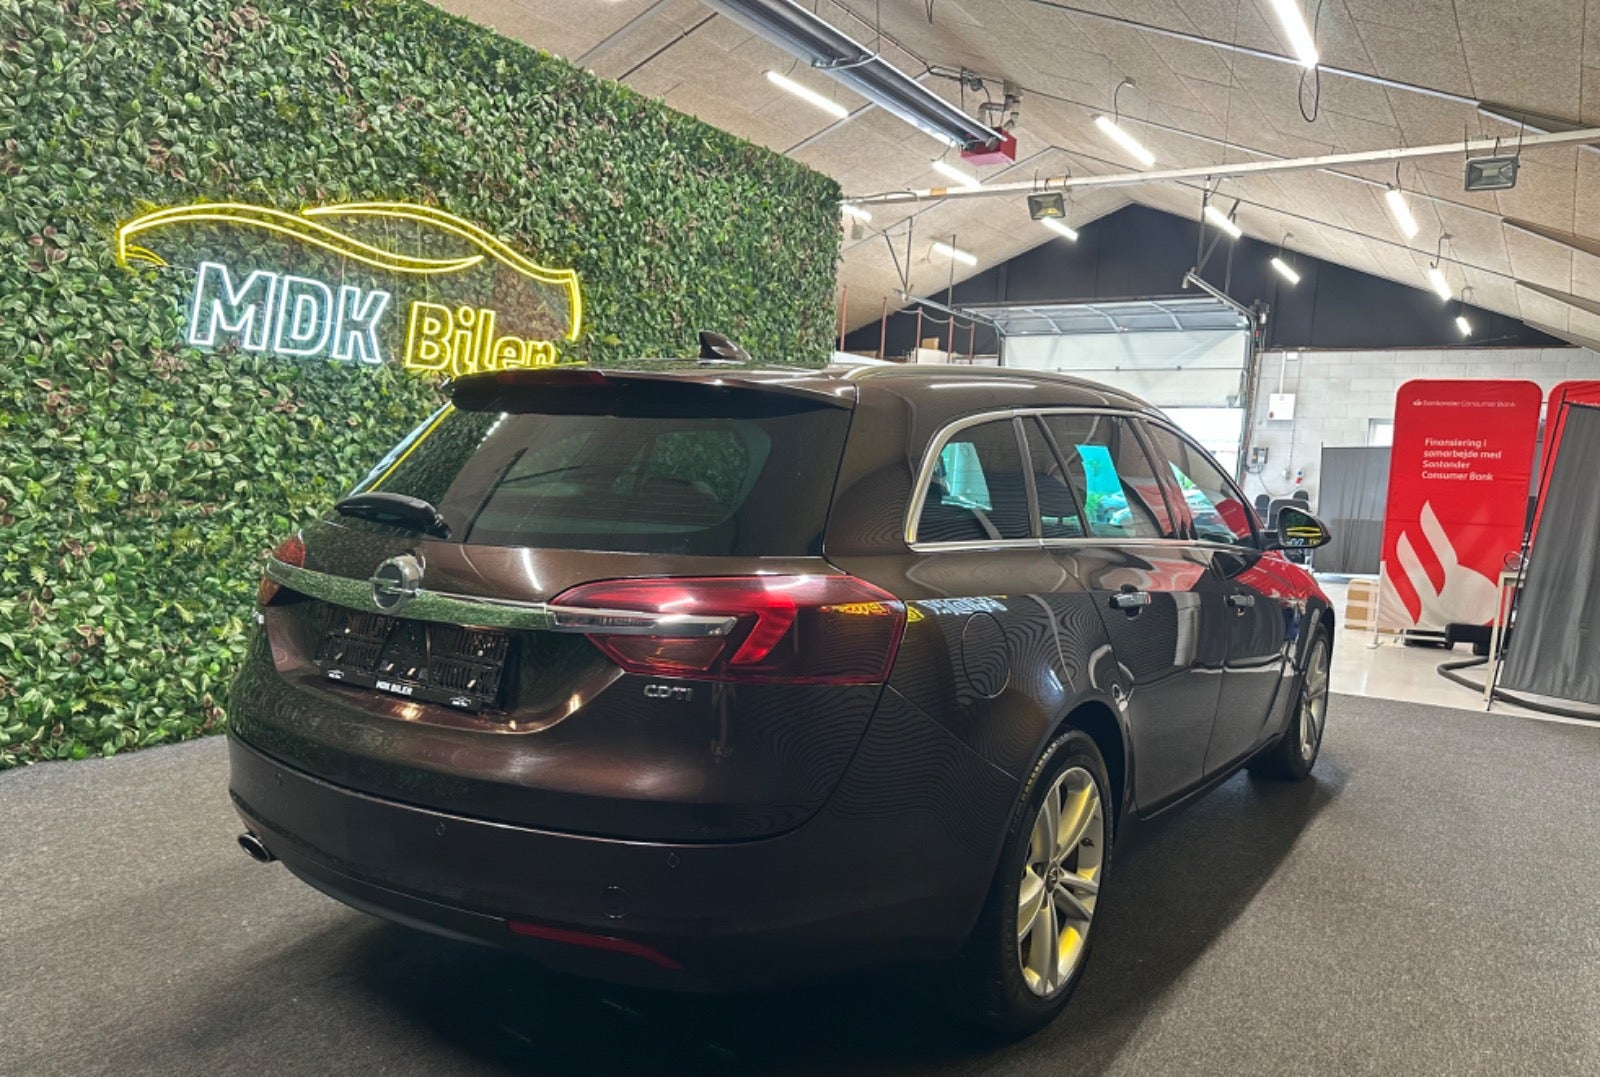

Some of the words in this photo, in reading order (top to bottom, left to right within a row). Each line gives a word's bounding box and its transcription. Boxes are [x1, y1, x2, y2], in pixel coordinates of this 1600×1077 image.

[188, 261, 391, 365] MDK
[1425, 437, 1482, 449] Finansiering
[1423, 449, 1479, 460] samarbejde
[1480, 450, 1502, 459] med
[1422, 460, 1470, 469] Santander
[1421, 471, 1468, 480] Consumer
[1469, 472, 1494, 481] Bank
